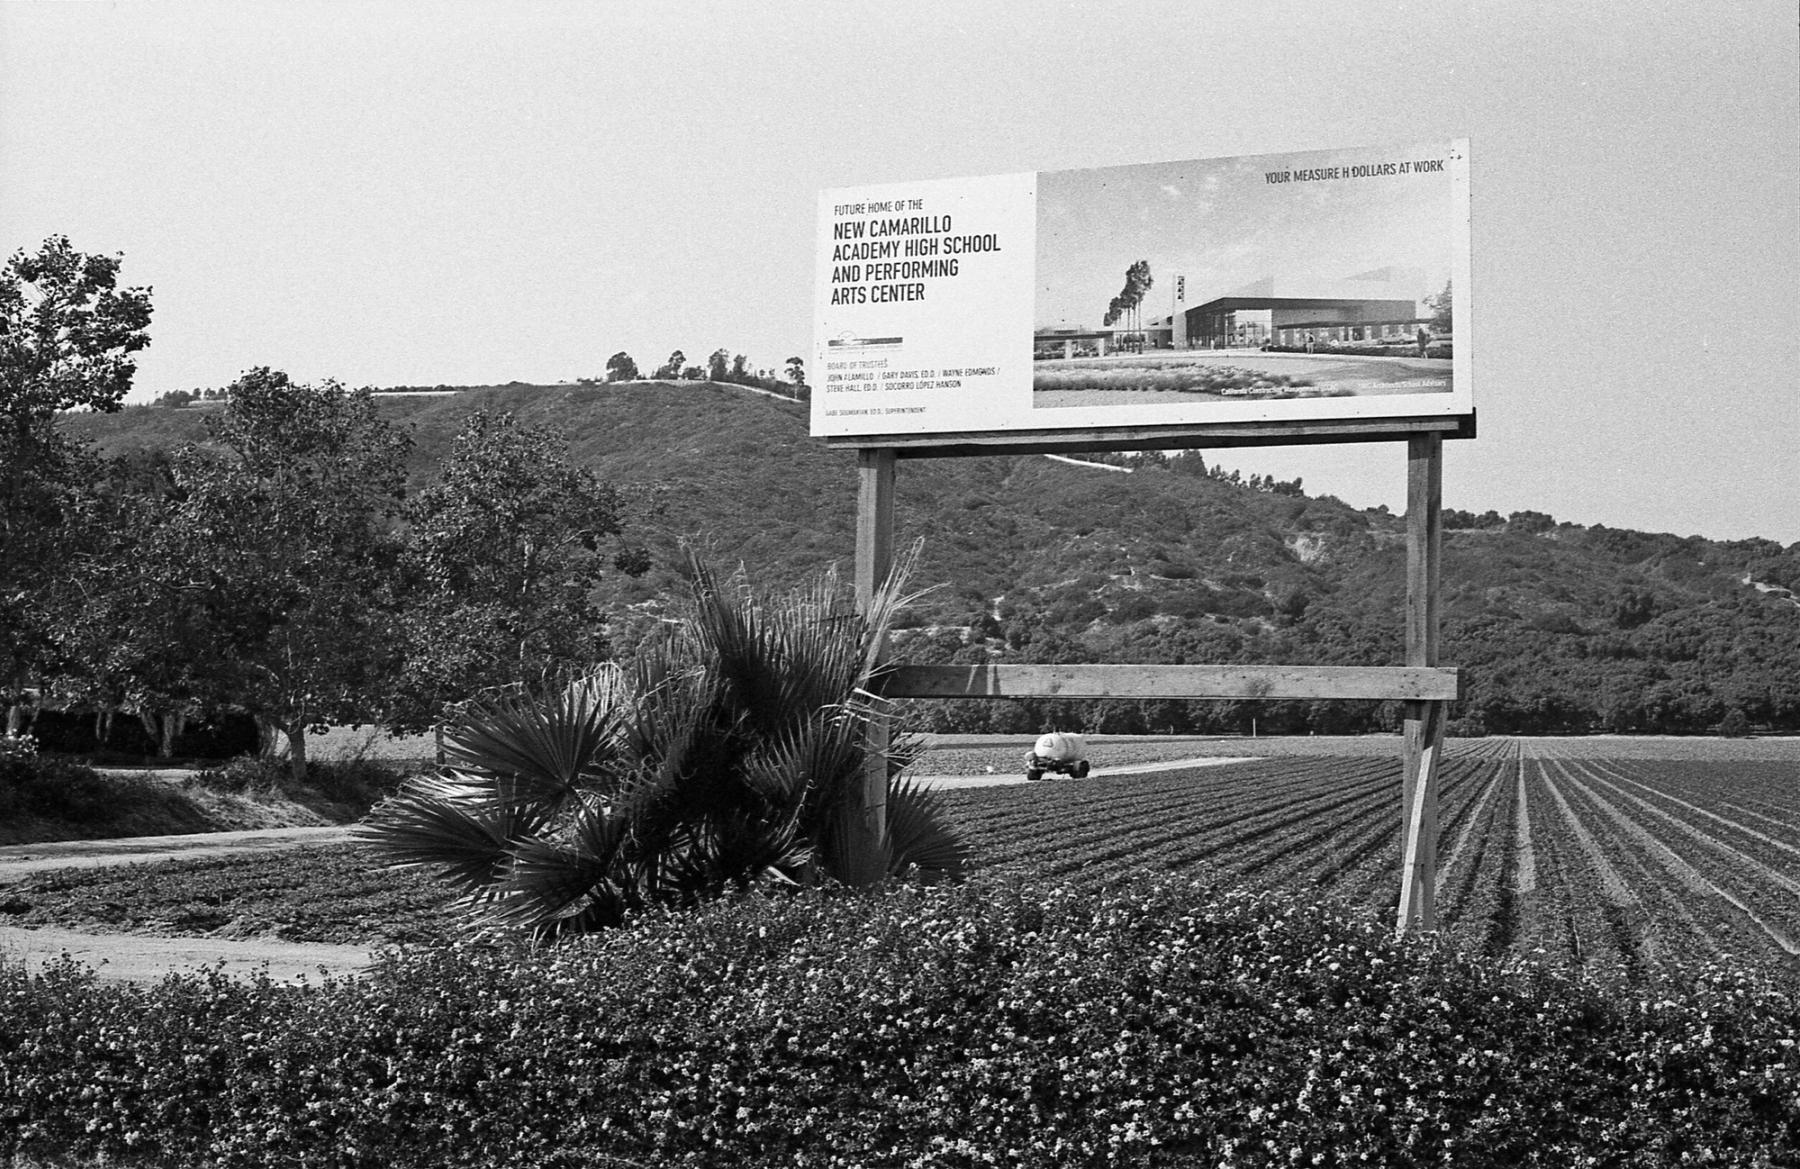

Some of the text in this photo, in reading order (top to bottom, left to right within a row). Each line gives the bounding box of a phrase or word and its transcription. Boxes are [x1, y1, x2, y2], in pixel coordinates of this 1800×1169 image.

[1265, 159, 1445, 184] YOUR MEASURE H DOLLARS AT WORK
[834, 199, 923, 216] FUTURE HOME OF THE
[834, 215, 952, 240] NEW CAMARILLO
[832, 233, 1001, 262] ACADEMY HIGH SCHOOL
[831, 258, 959, 284] AND PERFORMING
[831, 283, 925, 305] ARTS CENTER
